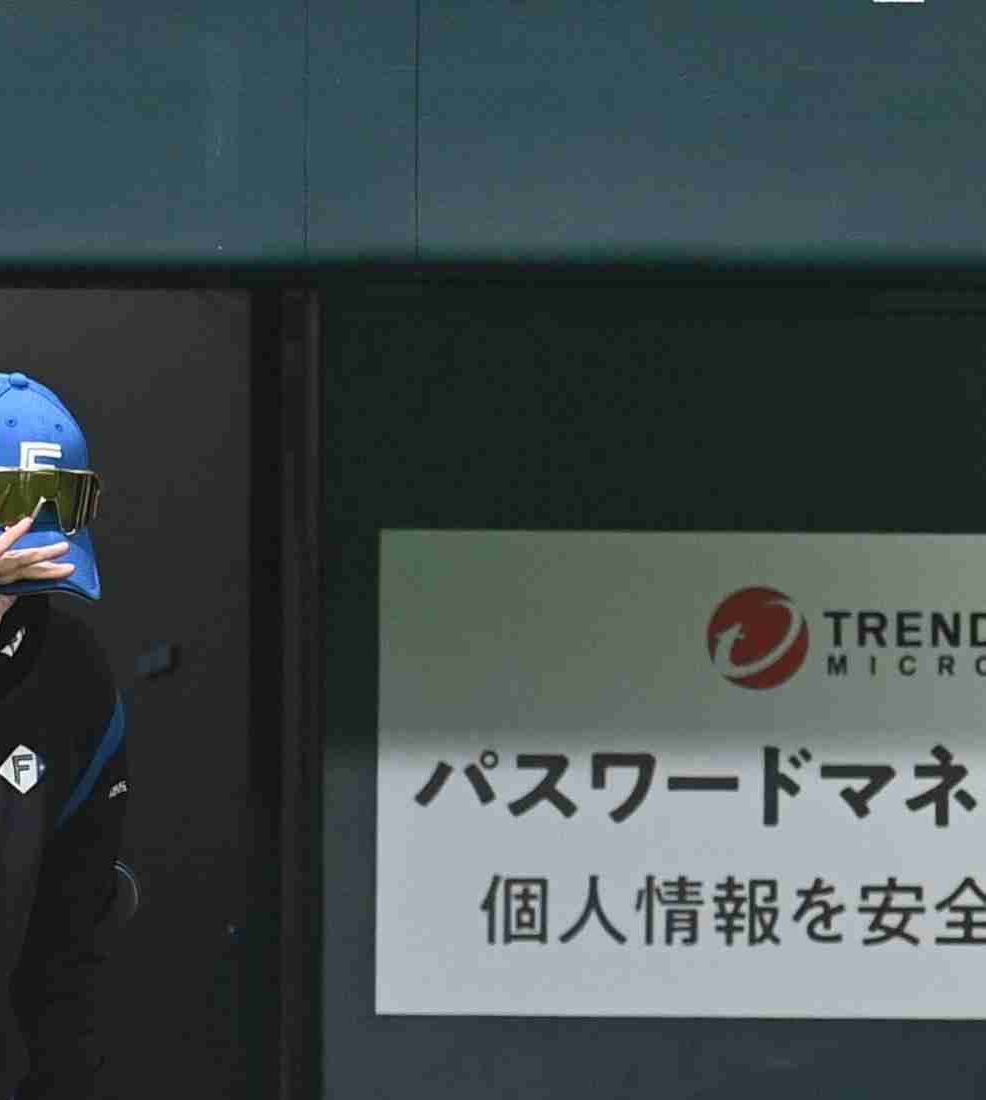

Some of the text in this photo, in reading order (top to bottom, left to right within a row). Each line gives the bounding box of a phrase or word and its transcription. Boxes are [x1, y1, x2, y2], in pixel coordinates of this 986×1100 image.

[823, 611, 986, 648] TREND
[827, 654, 986, 677] MICRO
[414, 744, 977, 828] パスワードマネ
[480, 874, 986, 947] 個人情報を安全
